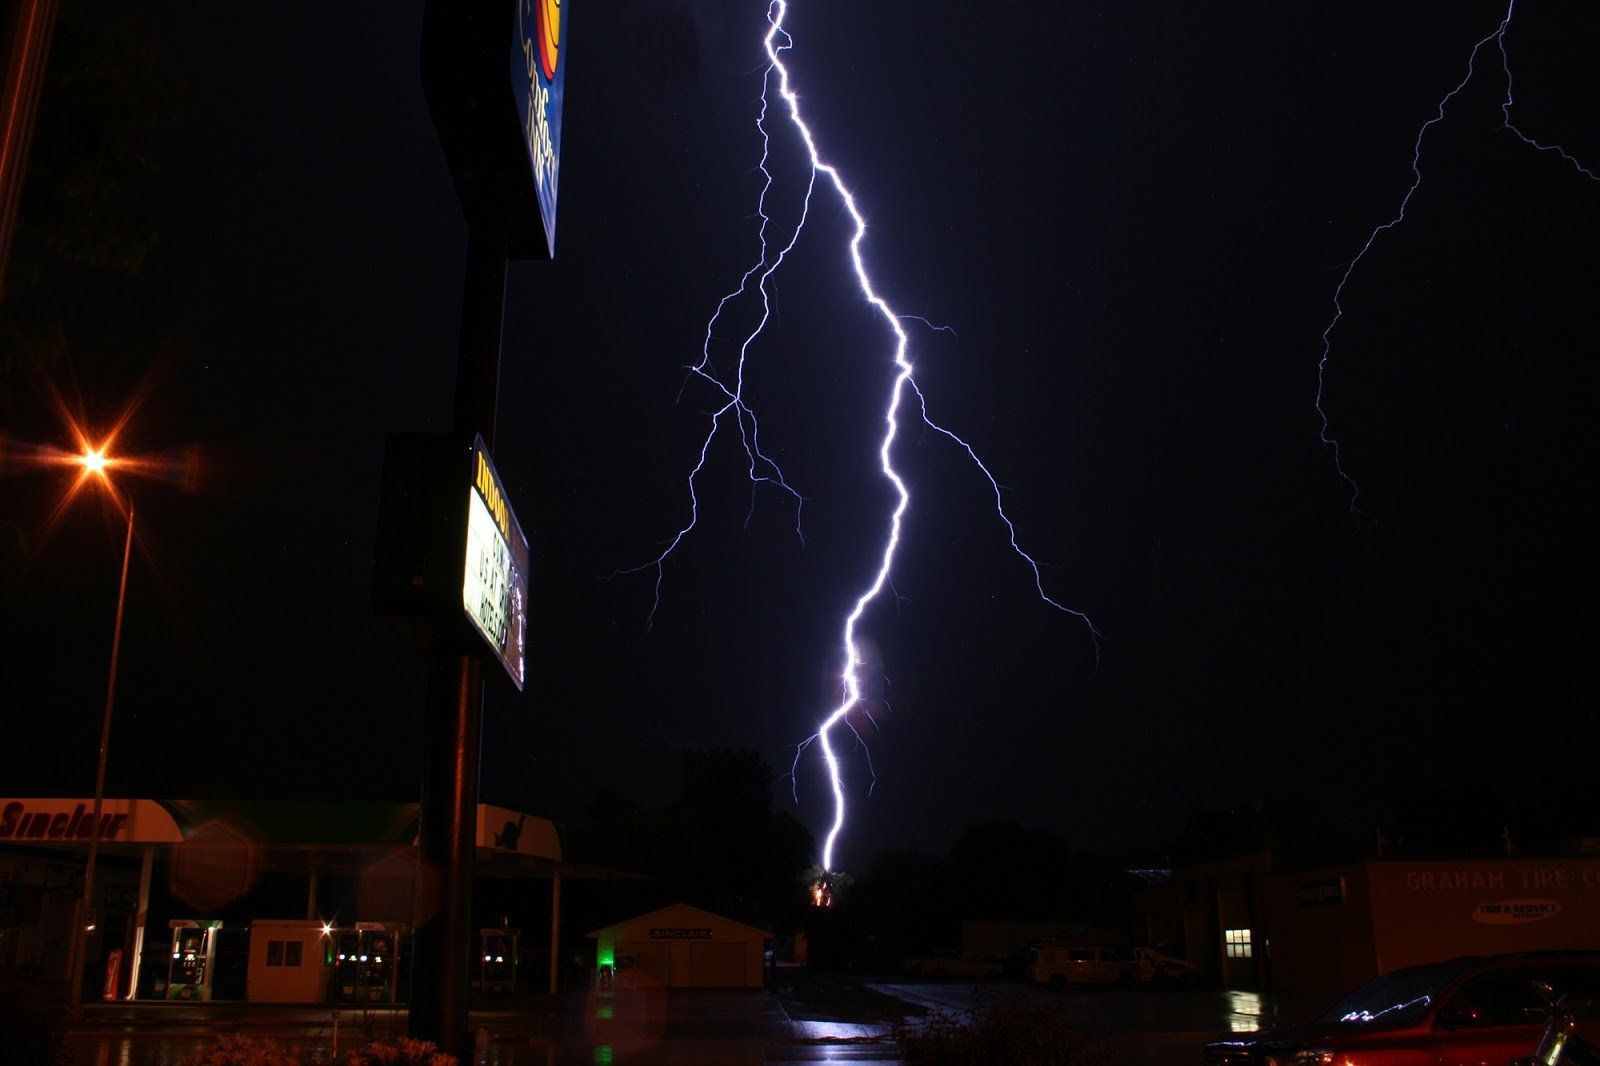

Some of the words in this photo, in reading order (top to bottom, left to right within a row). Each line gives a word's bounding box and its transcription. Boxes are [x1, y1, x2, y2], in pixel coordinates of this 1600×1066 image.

[0, 801, 128, 838] Sinclair
[1407, 871, 1505, 891] GRAHAM
[1519, 869, 1568, 889] TIRE
[654, 928, 709, 937] SINCLAIR
